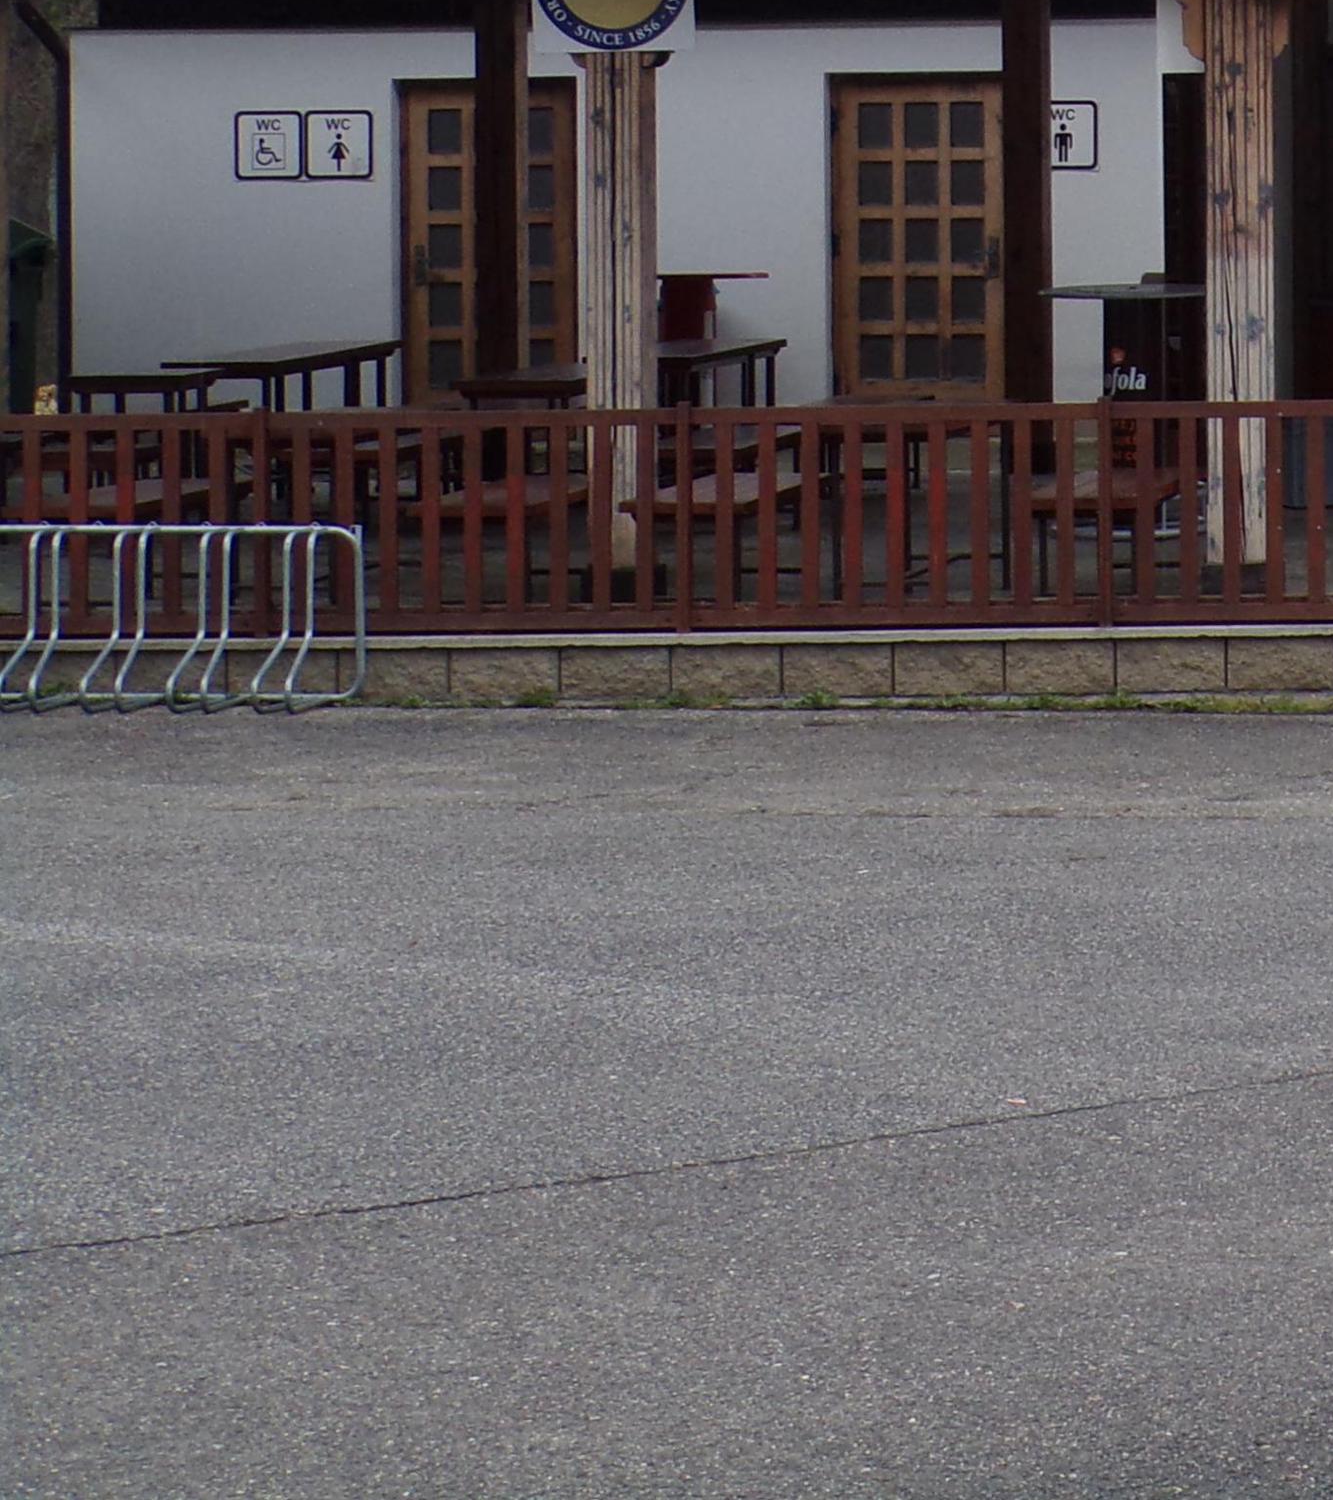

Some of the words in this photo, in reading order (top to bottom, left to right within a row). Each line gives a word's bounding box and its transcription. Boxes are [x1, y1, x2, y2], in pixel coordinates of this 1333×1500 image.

[574, 24, 626, 46] SINCE
[628, 19, 662, 43] 1856
[1050, 108, 1076, 121] WC
[255, 118, 282, 131] WC
[325, 118, 352, 131] WC
[1104, 366, 1147, 397] ofola
